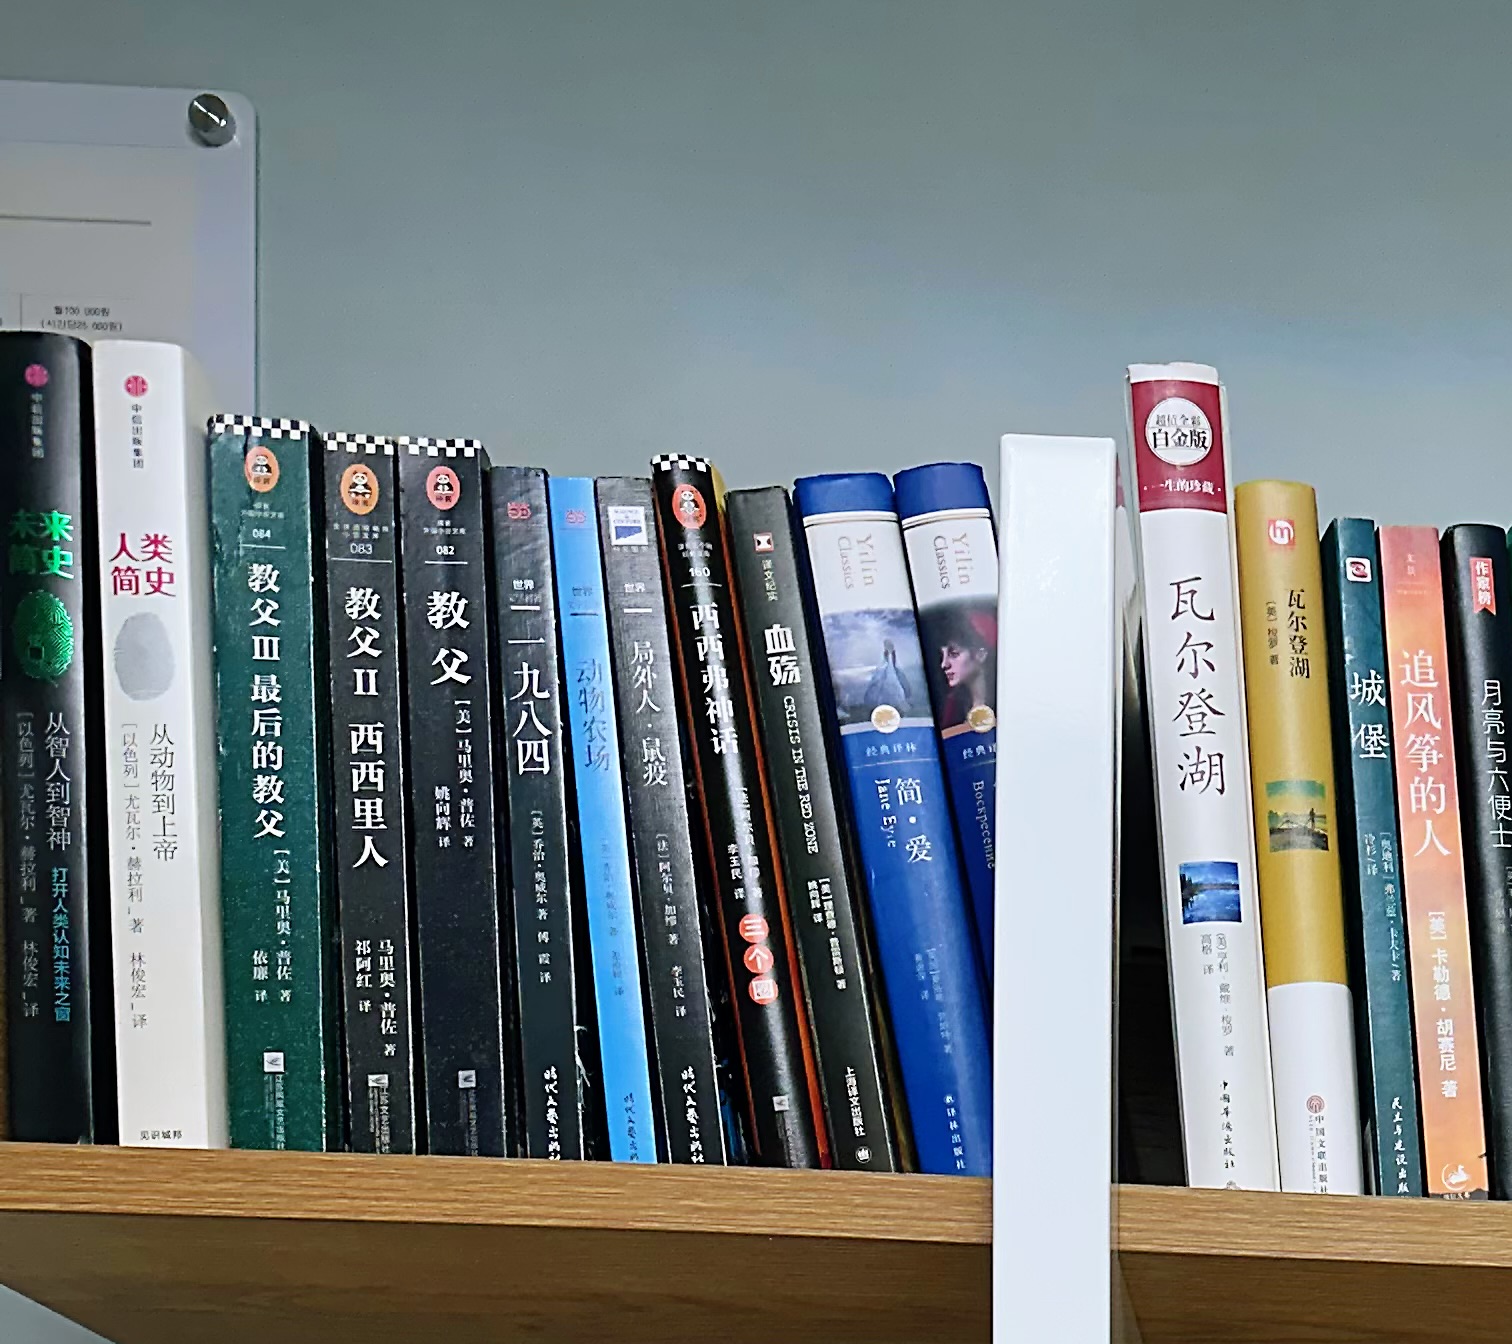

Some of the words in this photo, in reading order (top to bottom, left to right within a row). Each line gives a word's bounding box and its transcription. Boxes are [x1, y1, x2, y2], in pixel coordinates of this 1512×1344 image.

[1151, 427, 1209, 451] 白金版
[110, 532, 174, 564] 人类
[112, 566, 176, 597] 简史
[350, 543, 373, 555] 083
[436, 545, 455, 556] 082
[688, 567, 711, 578] 160
[933, 535, 951, 590] Classics
[1475, 561, 1491, 605] 作家榜
[426, 590, 472, 686] 教父
[689, 603, 739, 755] 西西弗神话
[763, 623, 801, 686] 血殇
[1286, 588, 1311, 680] 瓦尔登湖
[508, 638, 553, 776] 一九八四
[1169, 575, 1226, 797] 瓦尔登湖
[1350, 669, 1390, 760] 城堡
[44, 711, 72, 851] 从智人到智神
[149, 723, 177, 861] 从动物到上帝
[1398, 649, 1452, 858] 追风筝的人
[1481, 679, 1512, 849] 月亮与六便士
[895, 777, 933, 864] 简·爱
[51, 867, 71, 1022] 打开人类认知未来之窗
